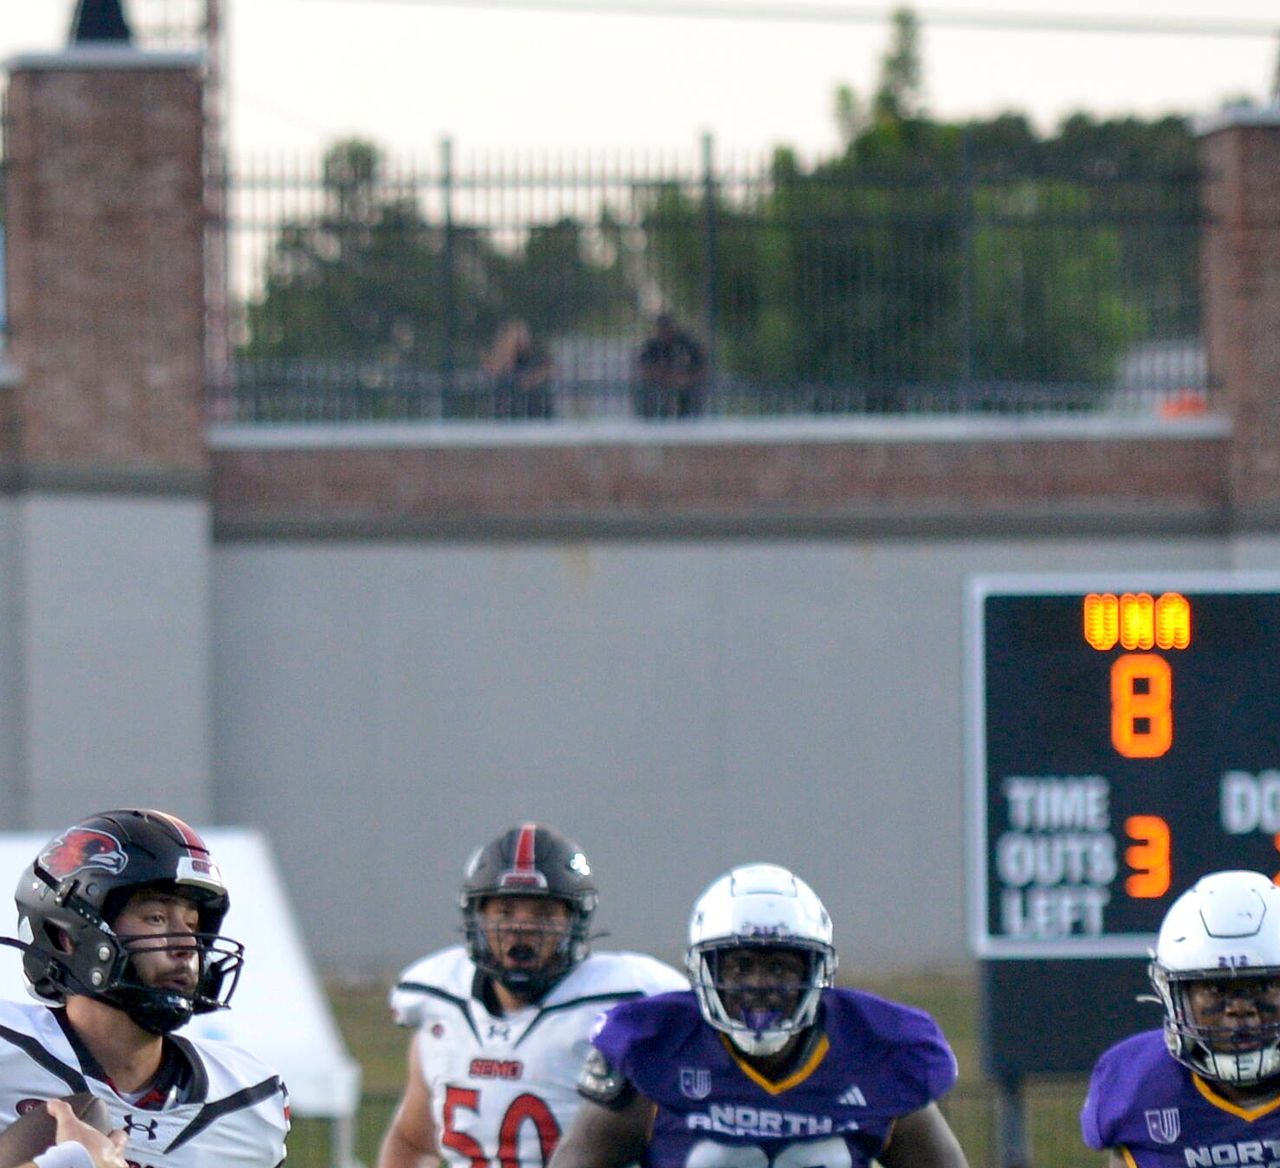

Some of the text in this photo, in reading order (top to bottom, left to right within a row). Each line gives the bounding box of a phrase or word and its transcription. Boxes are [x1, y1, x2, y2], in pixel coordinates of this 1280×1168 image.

[1083, 591, 1191, 650] UNA
[1110, 653, 1173, 758] 8
[1004, 775, 1111, 831] TIME
[997, 834, 1117, 886] OUTS
[1125, 814, 1171, 898] 3
[1002, 888, 1107, 937] LEFT
[468, 1058, 525, 1081] SEMO
[709, 1103, 833, 1136] NORTH
